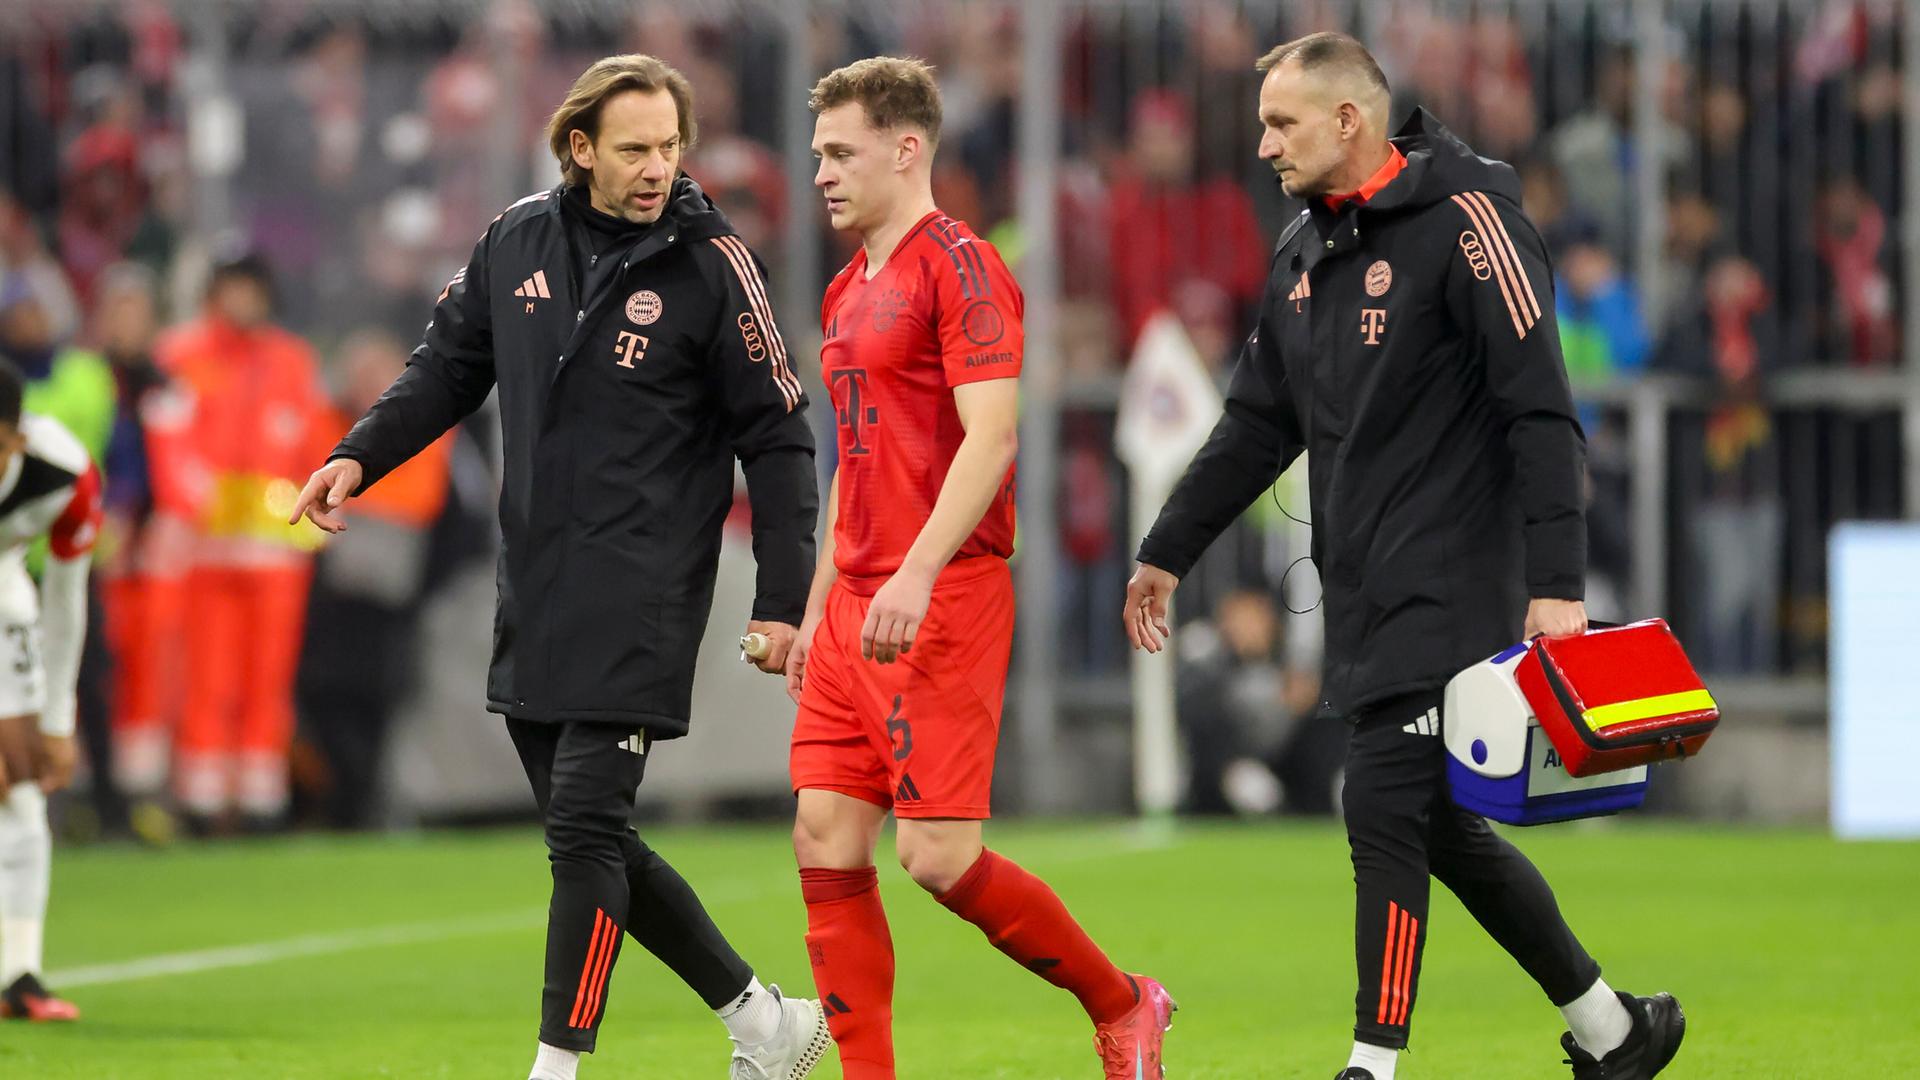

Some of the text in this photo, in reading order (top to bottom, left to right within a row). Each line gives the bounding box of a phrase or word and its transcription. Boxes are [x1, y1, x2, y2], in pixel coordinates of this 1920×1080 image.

[526, 302, 534, 313] M
[632, 292, 660, 310] FC BAYERN
[1361, 309, 1386, 344] T
[614, 330, 649, 369] T
[966, 352, 1013, 369] Allianz
[831, 369, 878, 455] T
[886, 694, 913, 762] 6
